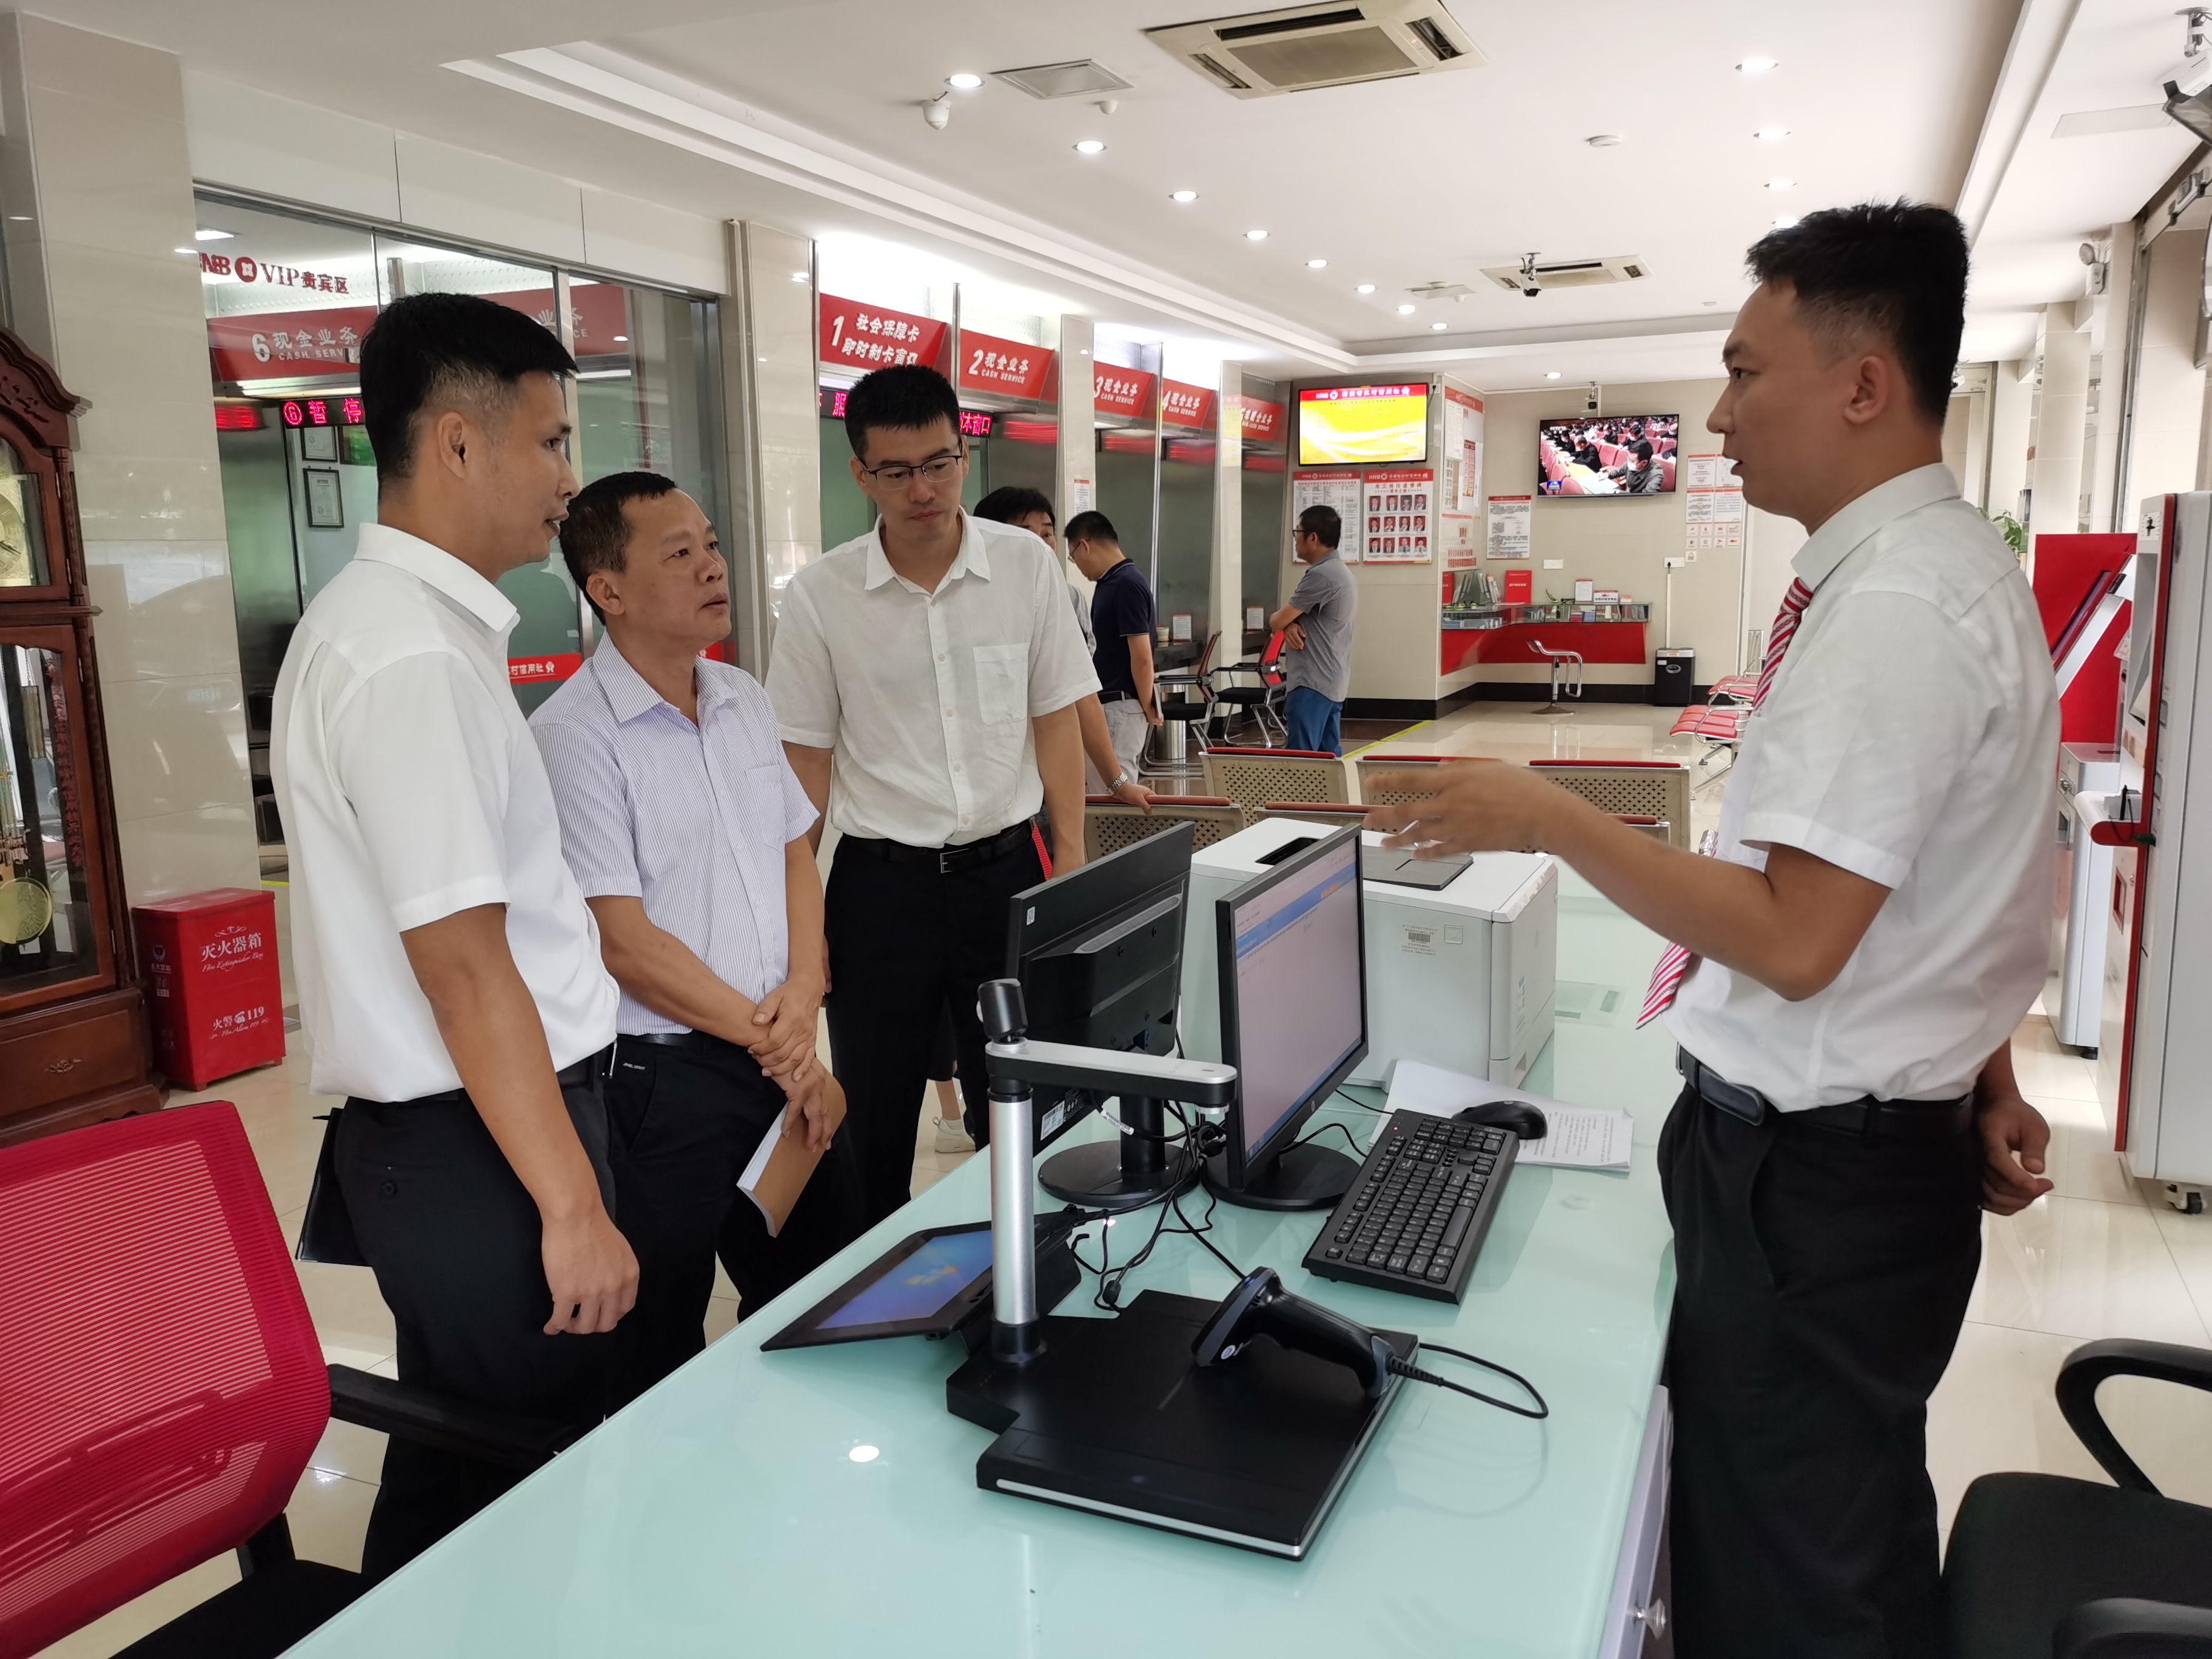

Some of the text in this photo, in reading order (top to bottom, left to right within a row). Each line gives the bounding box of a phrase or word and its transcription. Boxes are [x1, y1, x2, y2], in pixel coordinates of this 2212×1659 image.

[200, 252, 231, 275] NB
[831, 315, 845, 347] 1
[855, 312, 920, 343] 社会保障卡
[252, 326, 358, 363] 6 现金业务
[278, 348, 310, 361] CASH
[841, 337, 919, 366] 即时制卡窗口
[968, 349, 1030, 375] 2 现金业务
[981, 369, 1025, 384] CASH SERVICE
[1093, 376, 1139, 398] 3 现金业务
[1101, 393, 1134, 406] CASH SERVICE
[1162, 390, 1171, 411] 4
[1181, 407, 1197, 417] SERVICE
[509, 663, 544, 675] 村信用社
[202, 933, 262, 962] 灭火器箱
[247, 1006, 264, 1021] 119
